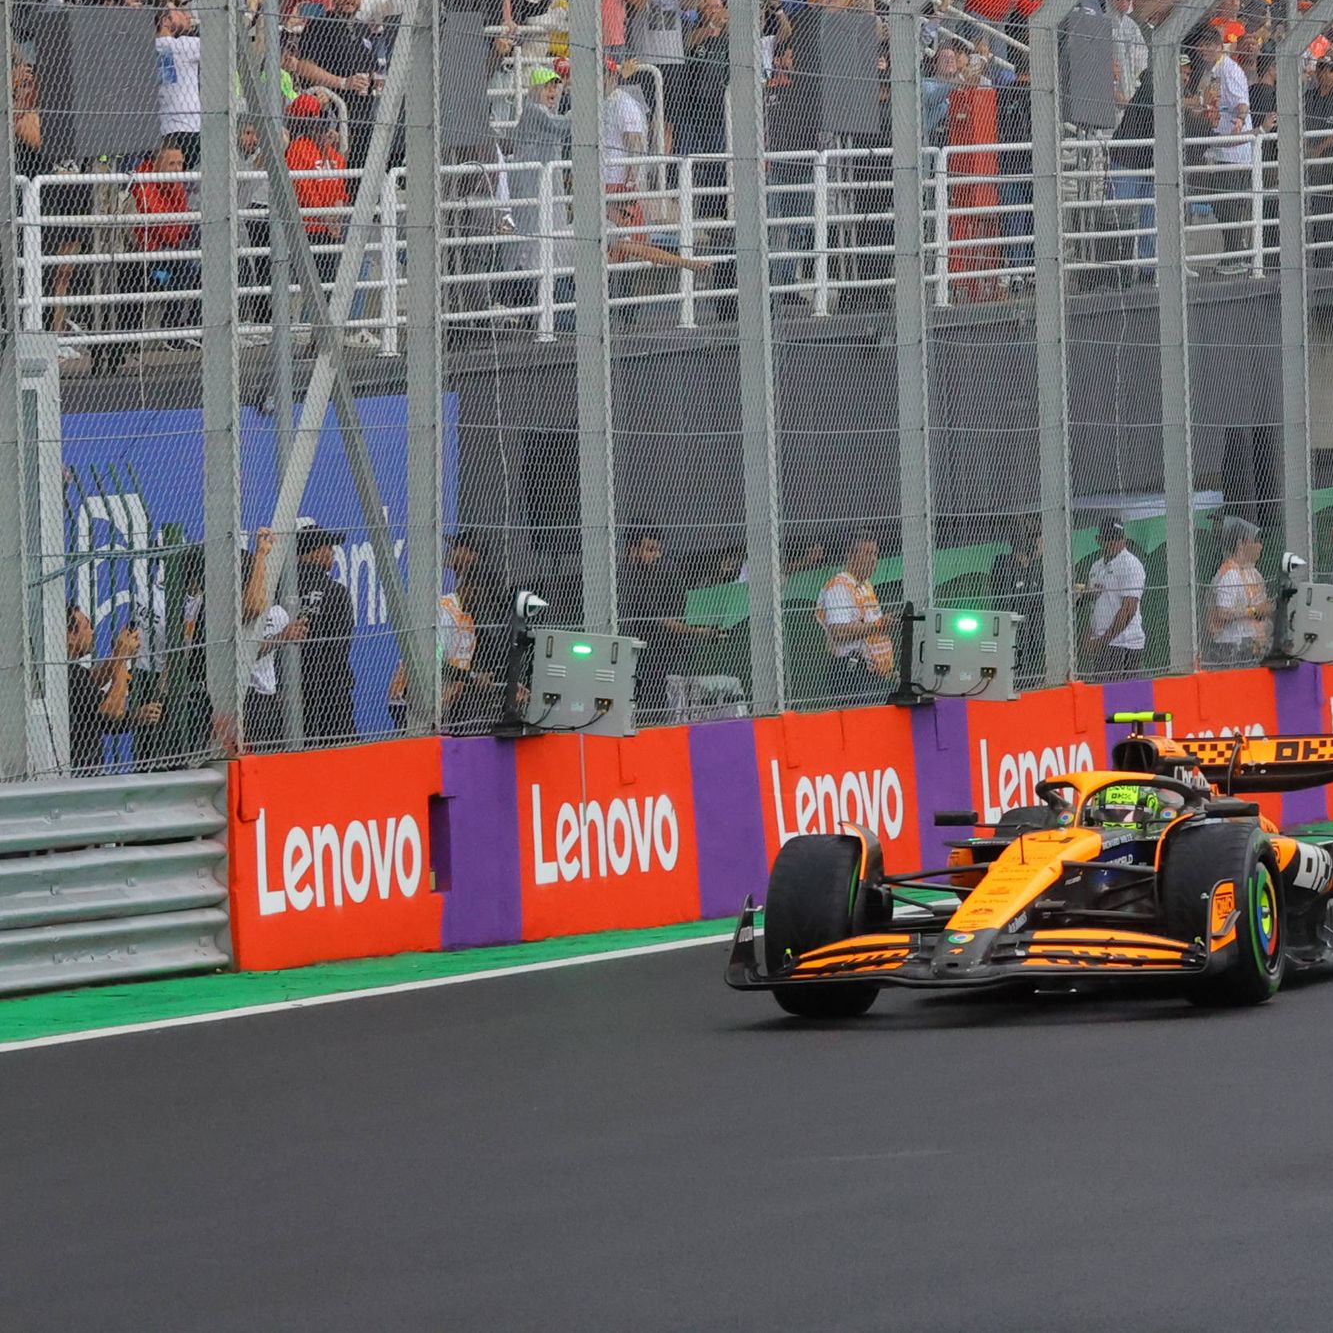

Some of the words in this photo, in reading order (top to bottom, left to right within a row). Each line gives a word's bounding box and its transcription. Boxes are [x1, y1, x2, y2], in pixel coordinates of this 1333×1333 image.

[770, 758, 904, 848] Lenovo
[980, 738, 1094, 826] Lenovo
[257, 807, 422, 916] Lenovo
[531, 782, 680, 885] Lenovo
